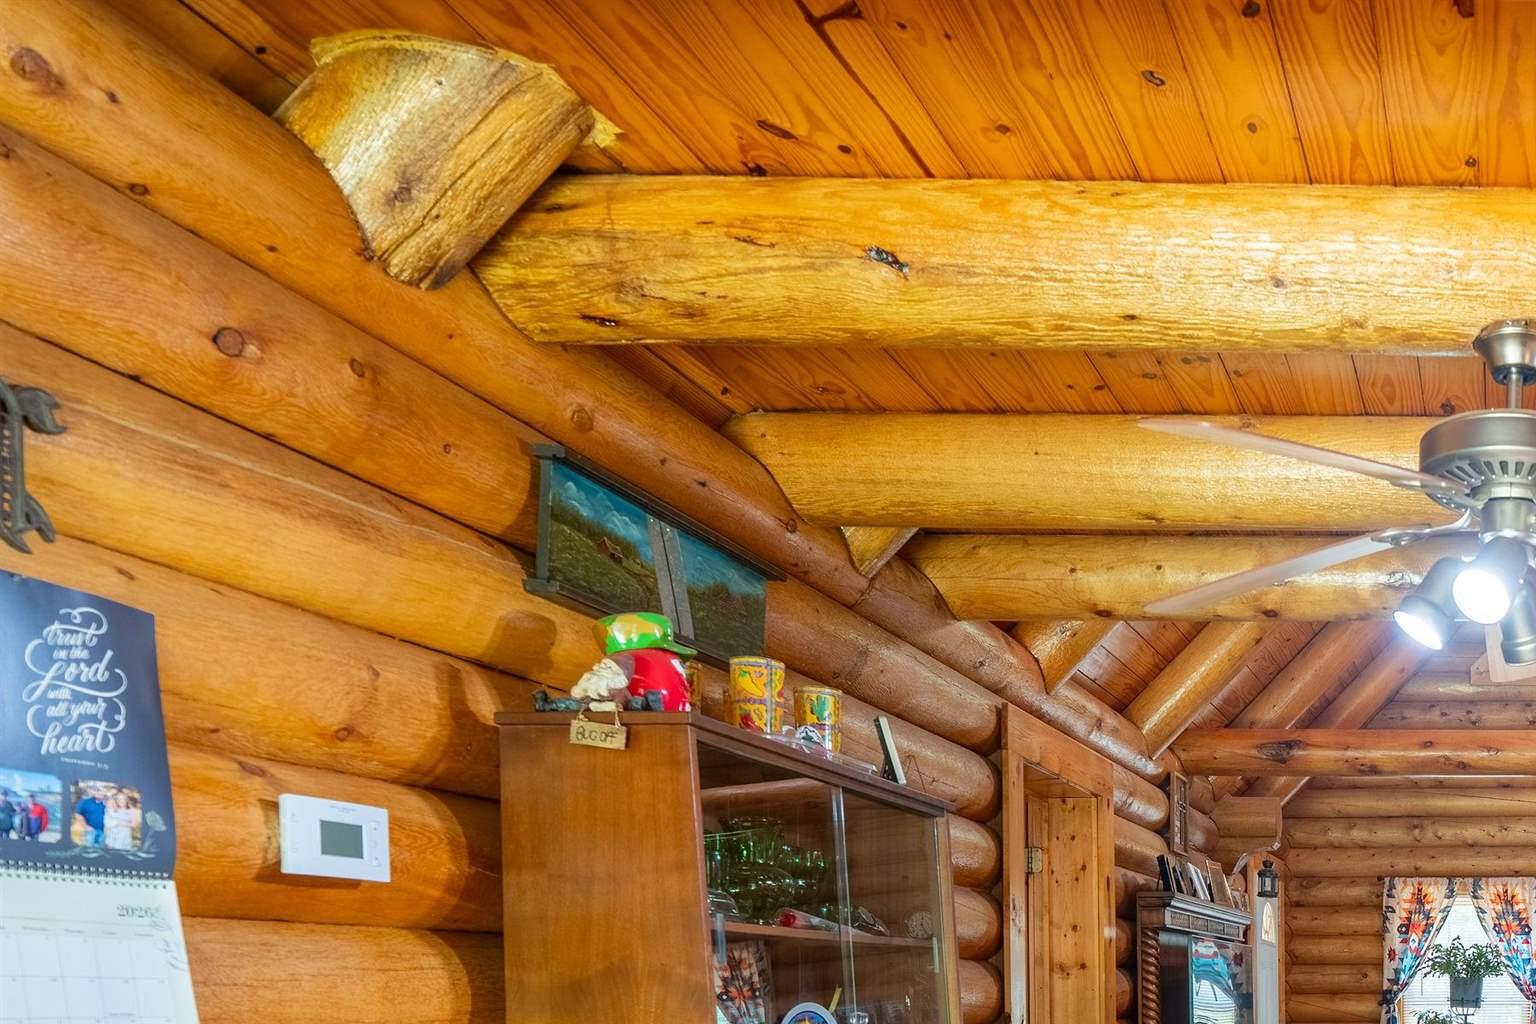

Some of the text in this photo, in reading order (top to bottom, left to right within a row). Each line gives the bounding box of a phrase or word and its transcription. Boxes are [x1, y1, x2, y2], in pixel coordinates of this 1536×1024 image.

[43, 618, 103, 647] trust
[24, 649, 114, 701] Lord
[46, 702, 69, 717] all
[38, 719, 116, 755] heart
